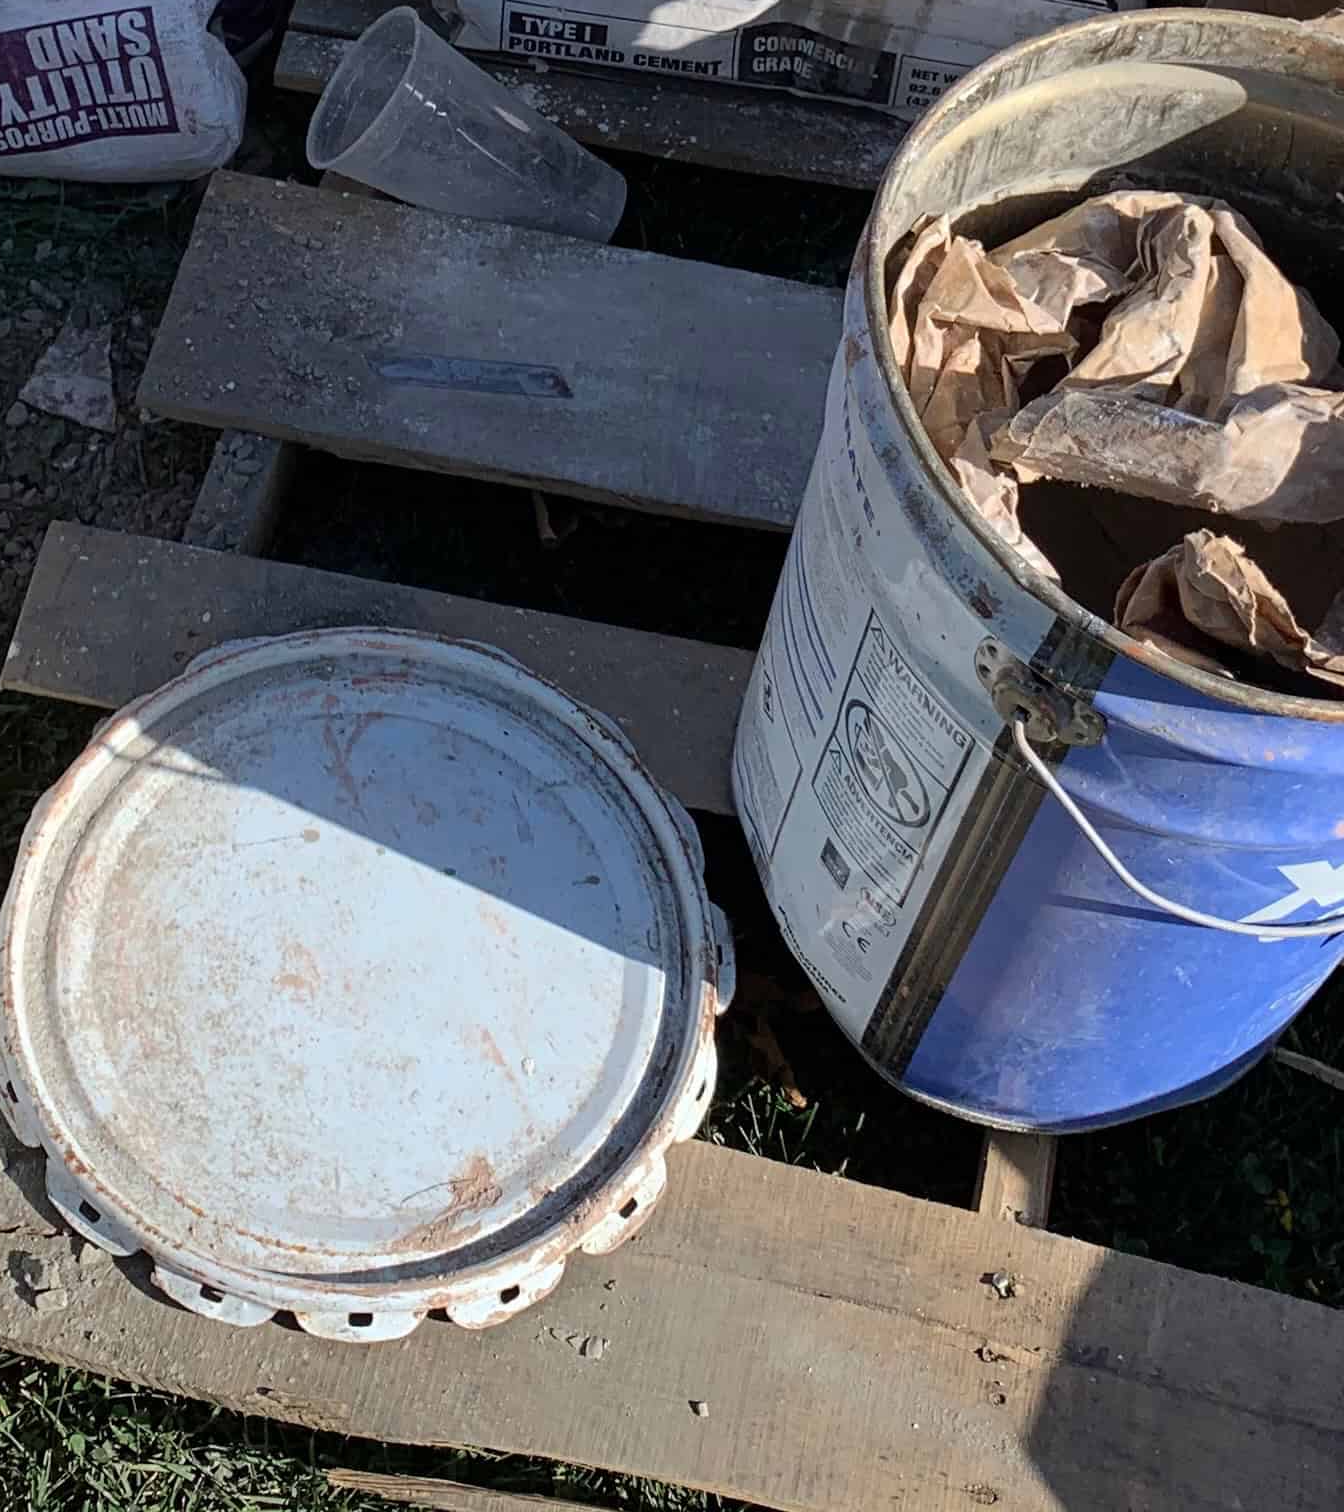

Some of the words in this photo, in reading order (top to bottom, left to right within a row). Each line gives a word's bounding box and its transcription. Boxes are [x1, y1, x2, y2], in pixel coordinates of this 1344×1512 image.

[25, 9, 152, 72] SAND
[521, 15, 579, 42] TYPE
[583, 24, 592, 43] I
[508, 36, 625, 65] PORTLAND
[633, 53, 723, 76] CEMENT
[752, 55, 813, 80] GRADE
[911, 69, 940, 82] NET
[887, 650, 967, 750] WARNING
[843, 774, 914, 863] ADVERTENCIA
